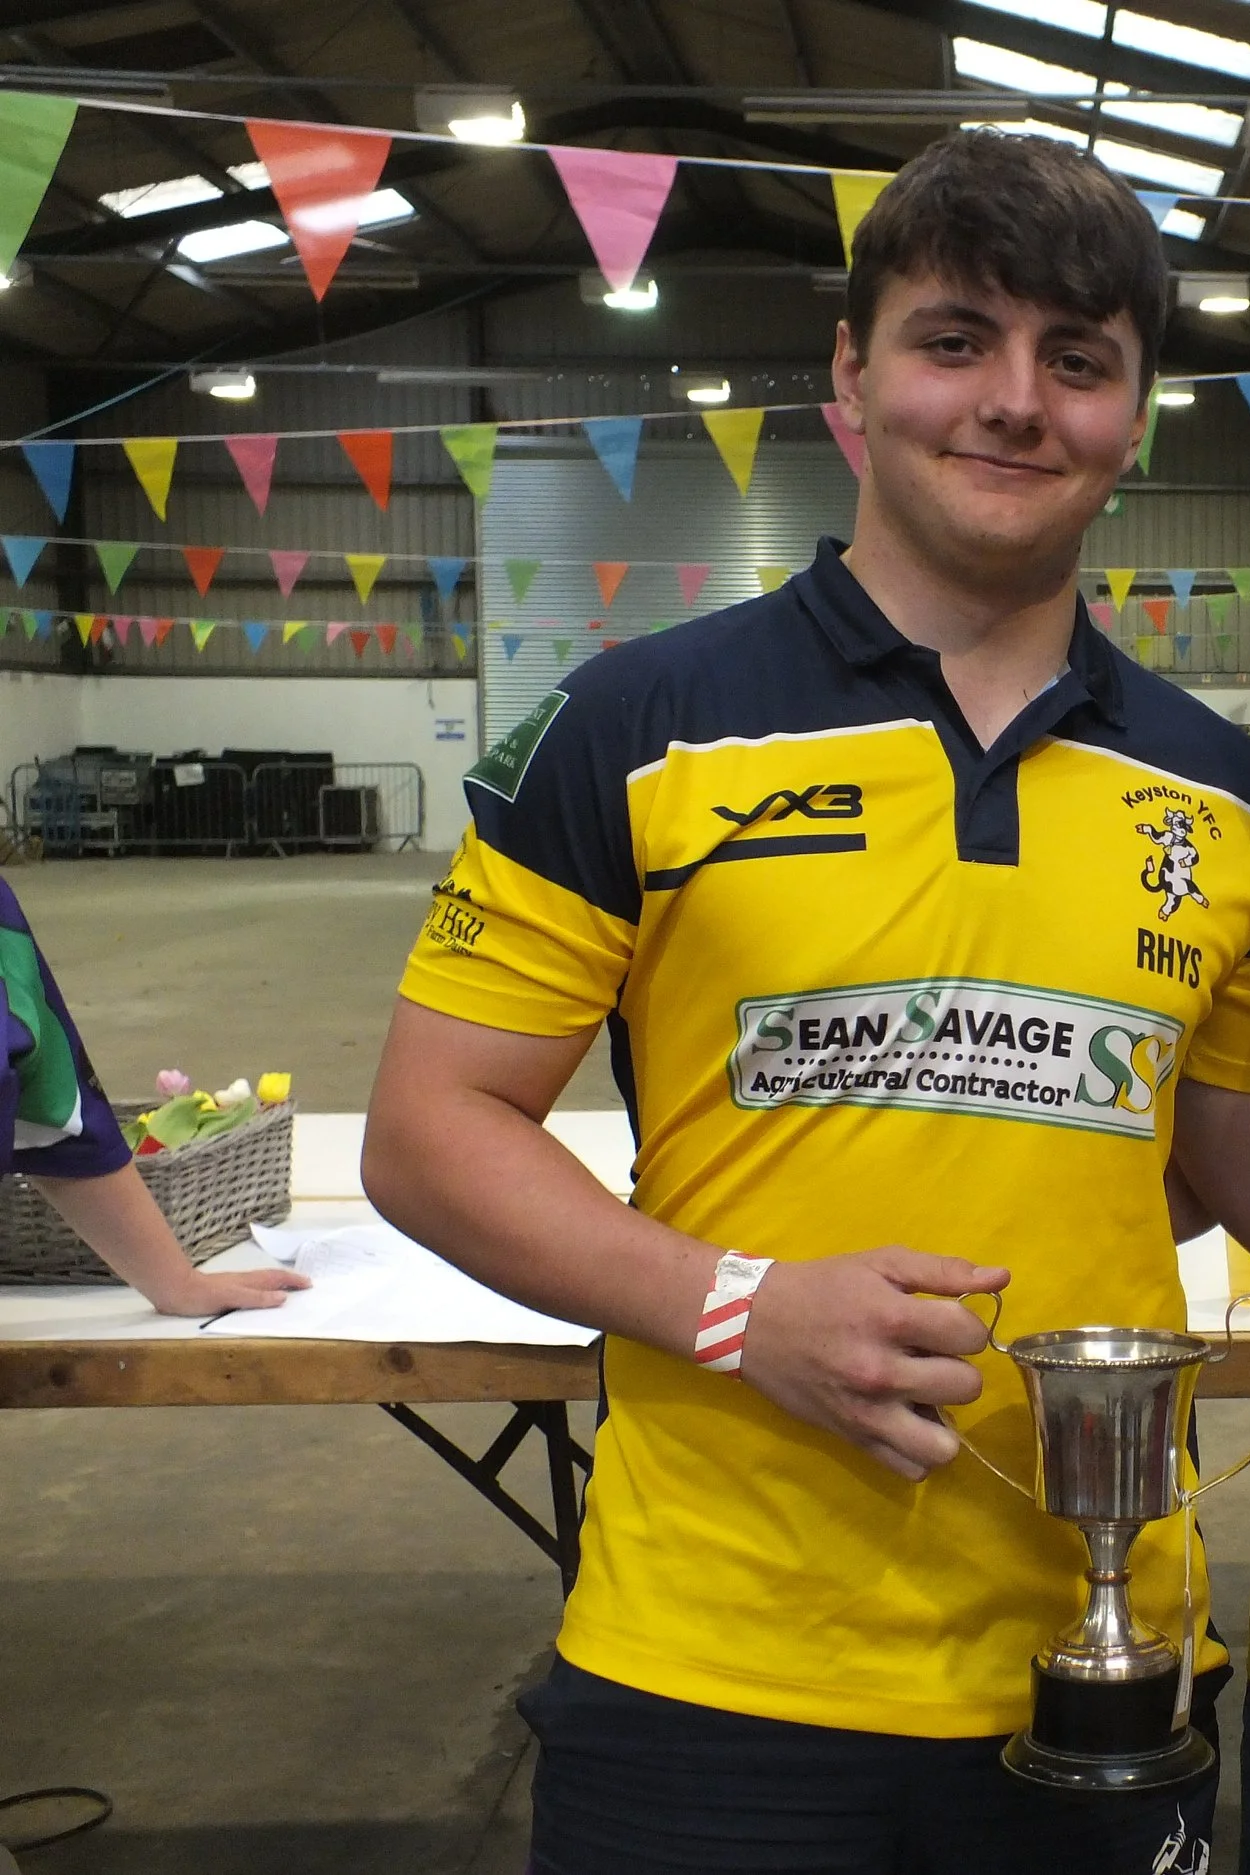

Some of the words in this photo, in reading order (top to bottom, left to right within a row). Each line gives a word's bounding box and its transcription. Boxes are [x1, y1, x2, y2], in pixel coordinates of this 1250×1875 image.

[711, 784, 864, 826] VX3
[1121, 785, 1192, 809] Keyston
[1196, 799, 1222, 841] YFC
[439, 903, 485, 946] Hill
[1137, 927, 1202, 989] RHYS
[752, 1007, 888, 1056] SEAN
[896, 990, 1075, 1058] SAVAGE
[751, 1066, 909, 1098] Agricultural
[916, 1068, 1071, 1107] Contractor
